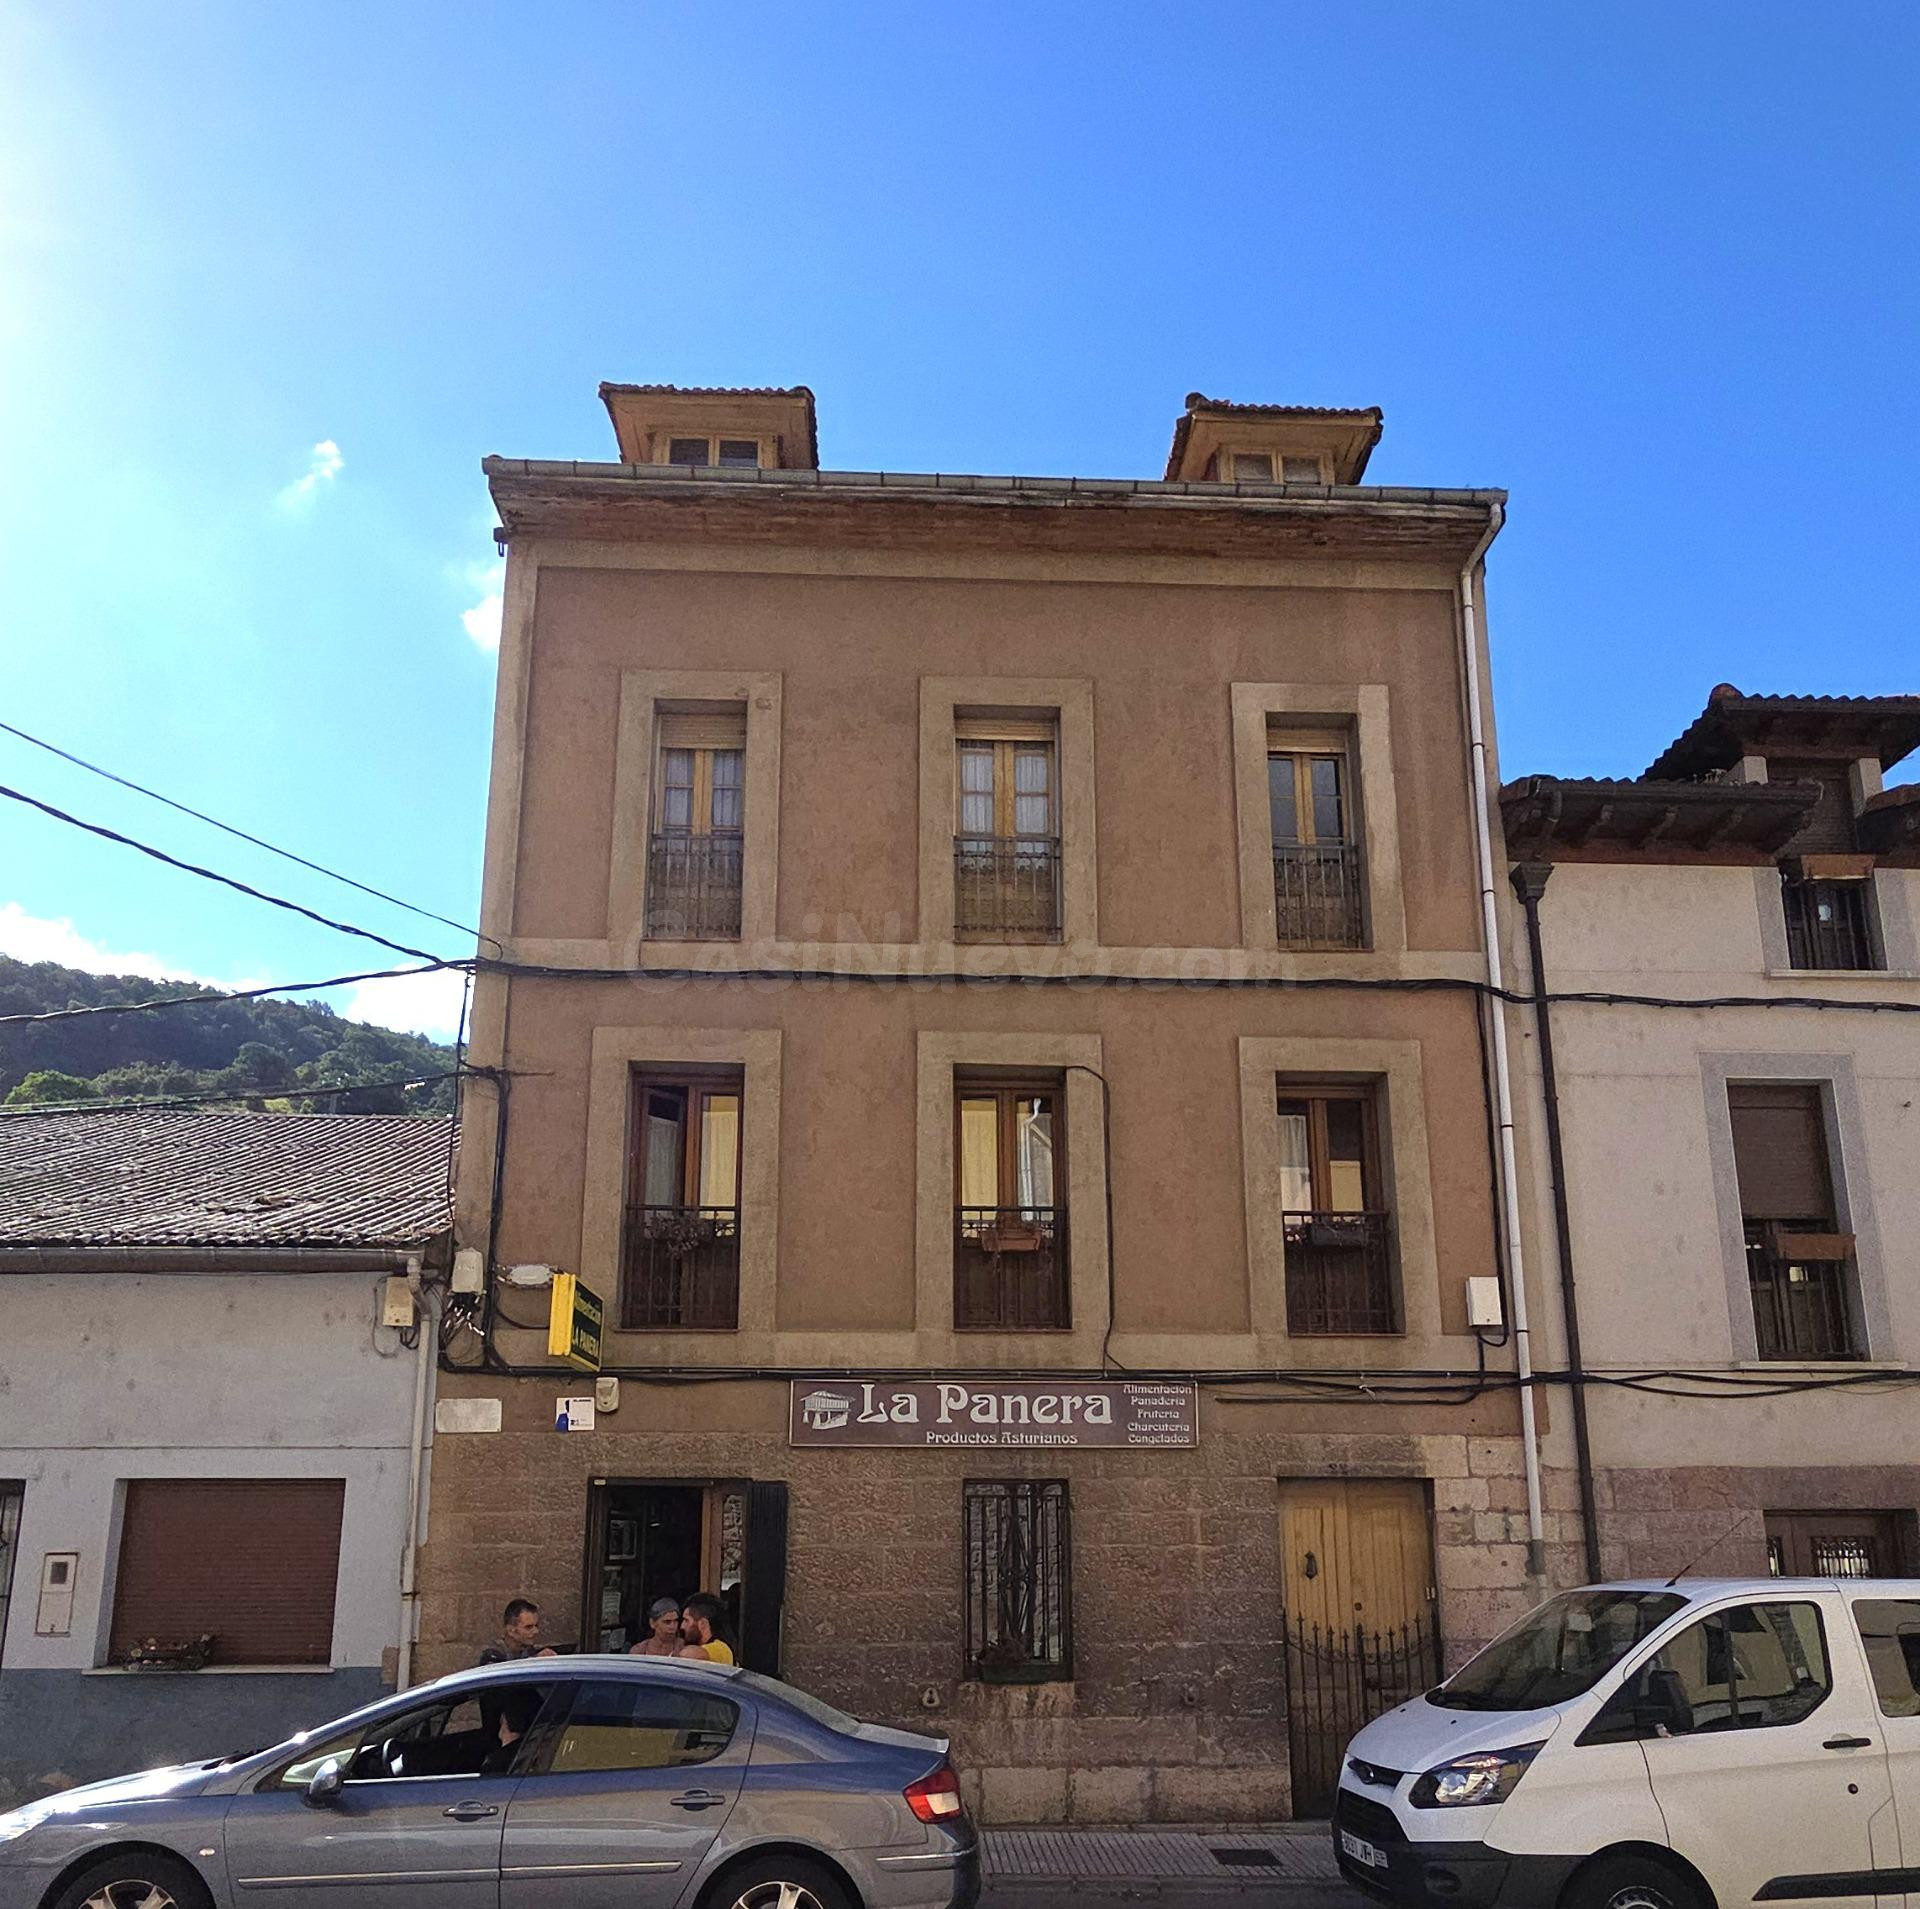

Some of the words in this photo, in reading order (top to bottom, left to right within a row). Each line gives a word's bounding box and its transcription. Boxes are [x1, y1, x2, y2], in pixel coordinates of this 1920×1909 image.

[856, 1384, 920, 1423] La
[936, 1384, 1113, 1424] Panera
[926, 1431, 997, 1444] Productos
[1001, 1431, 1078, 1444] Asturianos
[1128, 1434, 1190, 1445] Congelados
